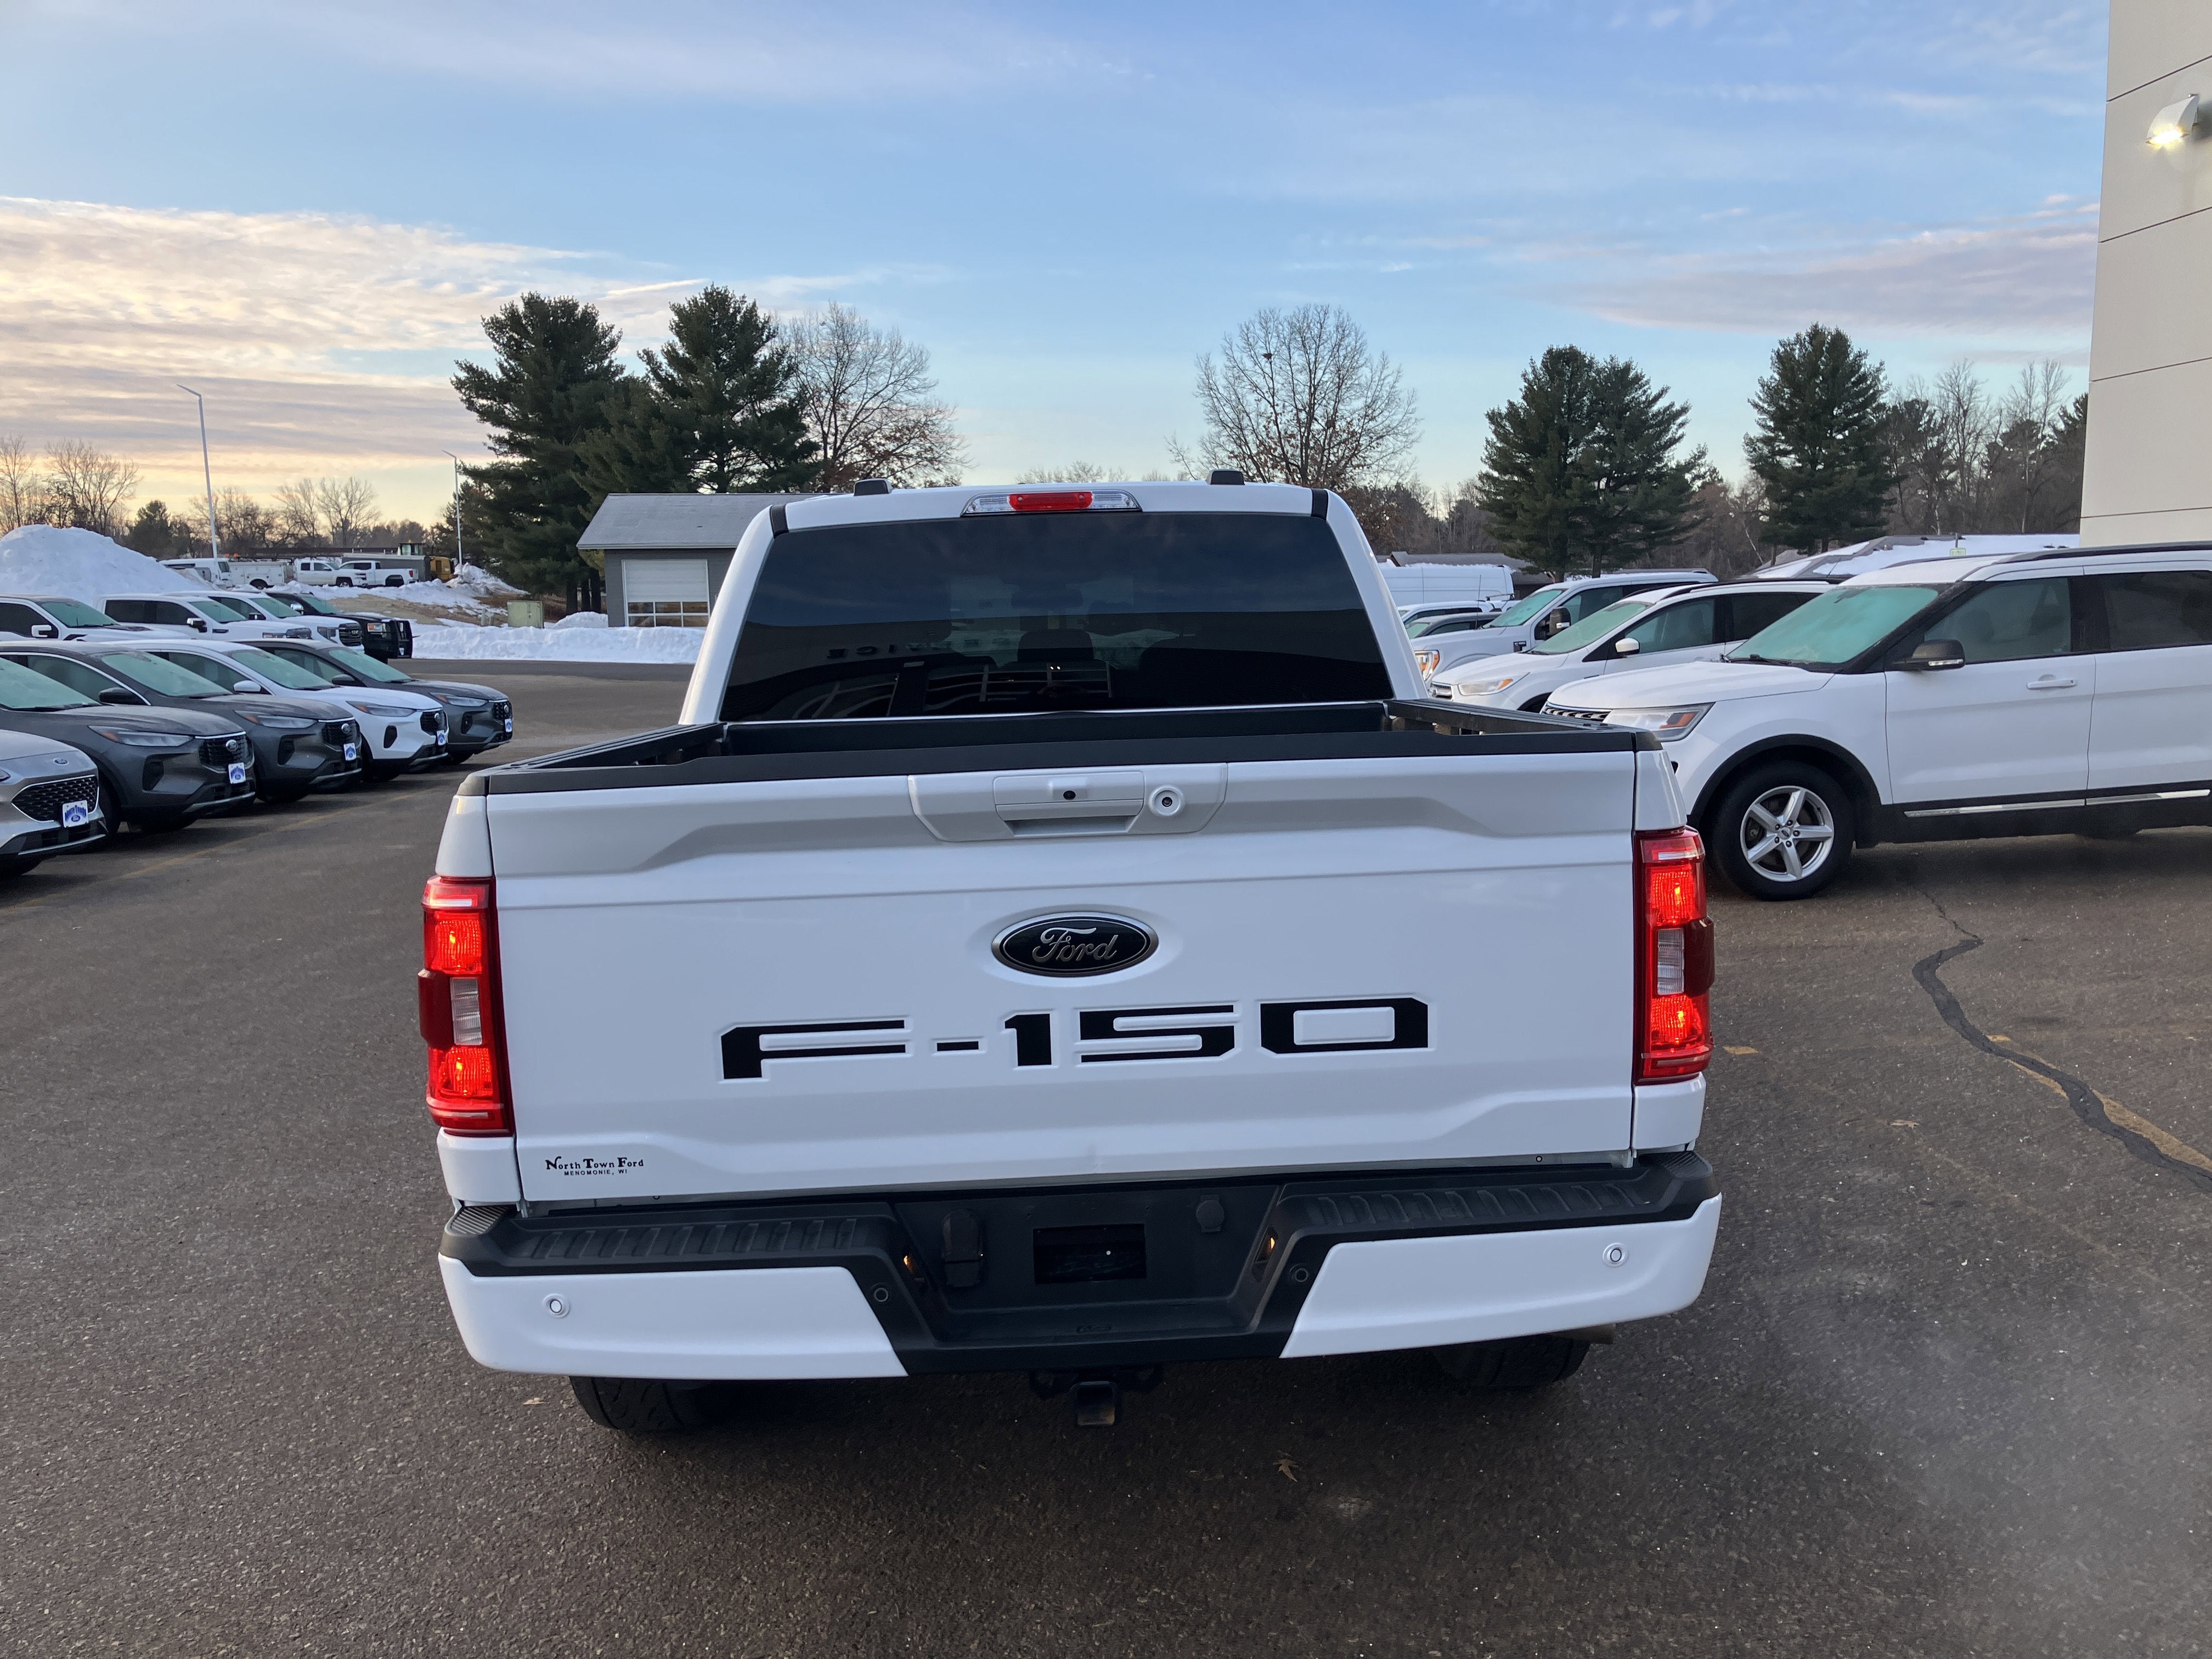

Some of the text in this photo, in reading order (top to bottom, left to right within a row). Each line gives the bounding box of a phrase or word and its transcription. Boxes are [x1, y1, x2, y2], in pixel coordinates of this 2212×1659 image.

[1032, 927, 1119, 962] Ford
[721, 997, 1429, 1080] F-150
[545, 1156, 644, 1170] North Town Ford
